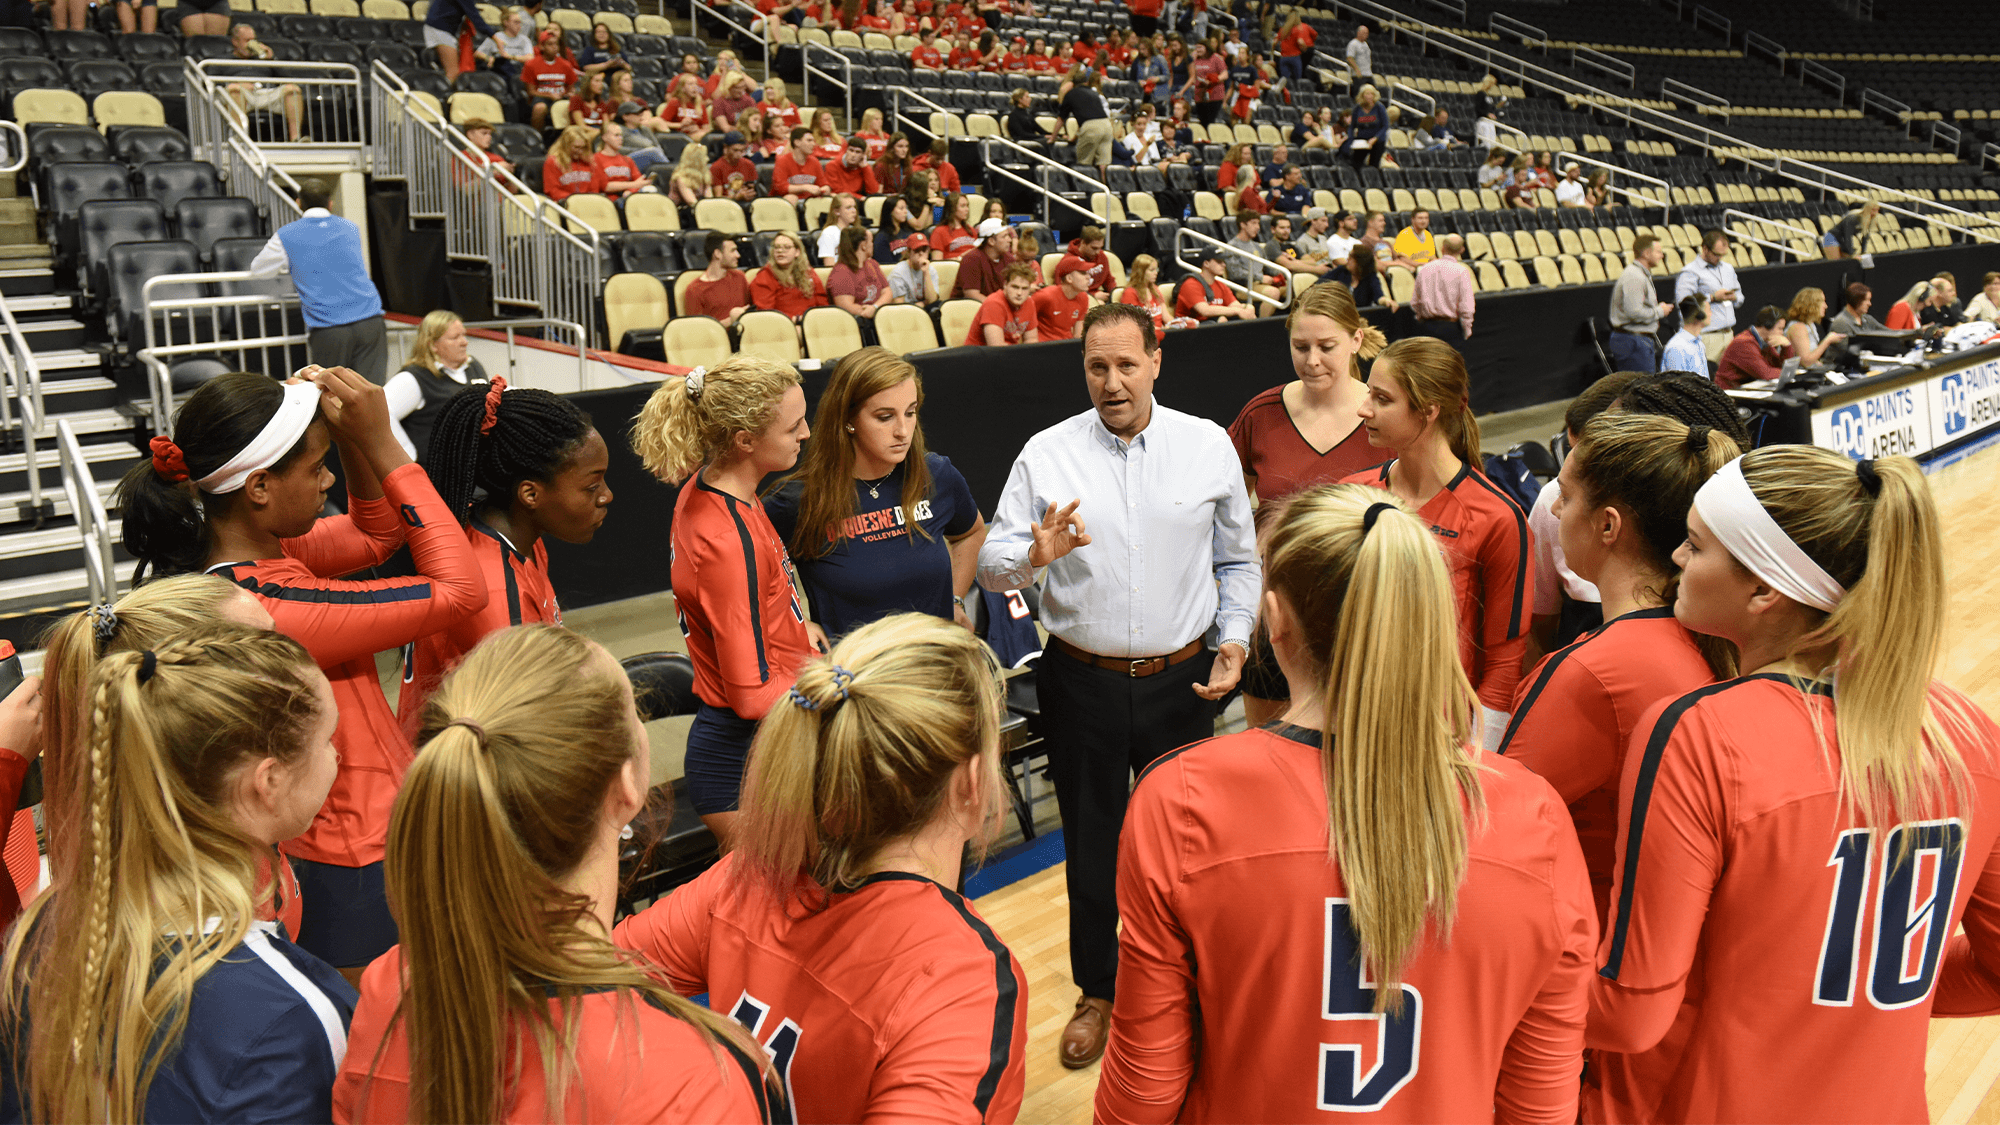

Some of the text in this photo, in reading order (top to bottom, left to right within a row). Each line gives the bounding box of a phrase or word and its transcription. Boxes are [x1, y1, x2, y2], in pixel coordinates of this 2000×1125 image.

[1966, 362, 2000, 394] PAINTS
[1866, 389, 1914, 427] PAINTS
[1943, 376, 1966, 432] PPG
[1832, 406, 1865, 459] PPG
[1872, 425, 1917, 460] ARENA
[894, 499, 934, 526] DKES
[1812, 817, 1968, 1010] 10
[1317, 897, 1423, 1113] 5
